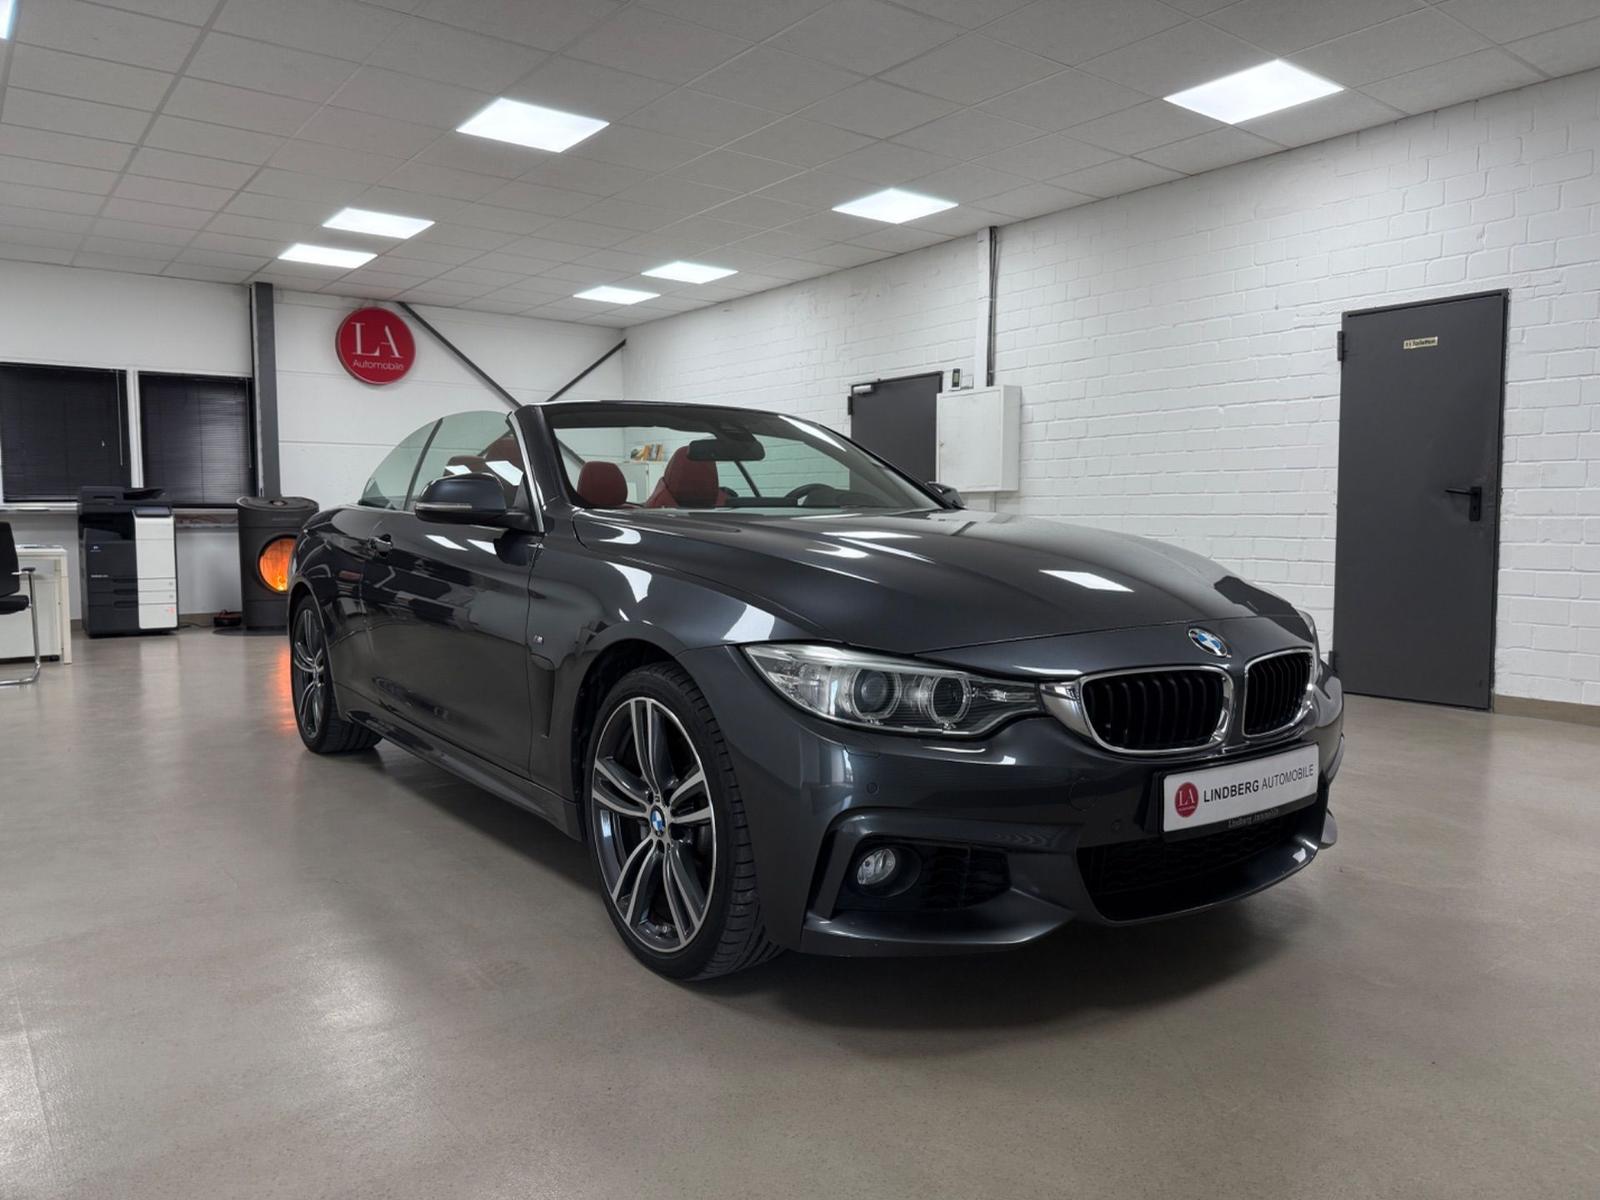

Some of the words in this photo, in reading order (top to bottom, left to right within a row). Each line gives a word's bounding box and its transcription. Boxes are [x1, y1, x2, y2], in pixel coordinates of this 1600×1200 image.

[351, 322, 403, 358] LA
[352, 359, 404, 371] Automobile
[1178, 788, 1196, 806] LA
[1203, 780, 1259, 803] LINDBERG
[1261, 764, 1314, 791] AUTOMOBILE
